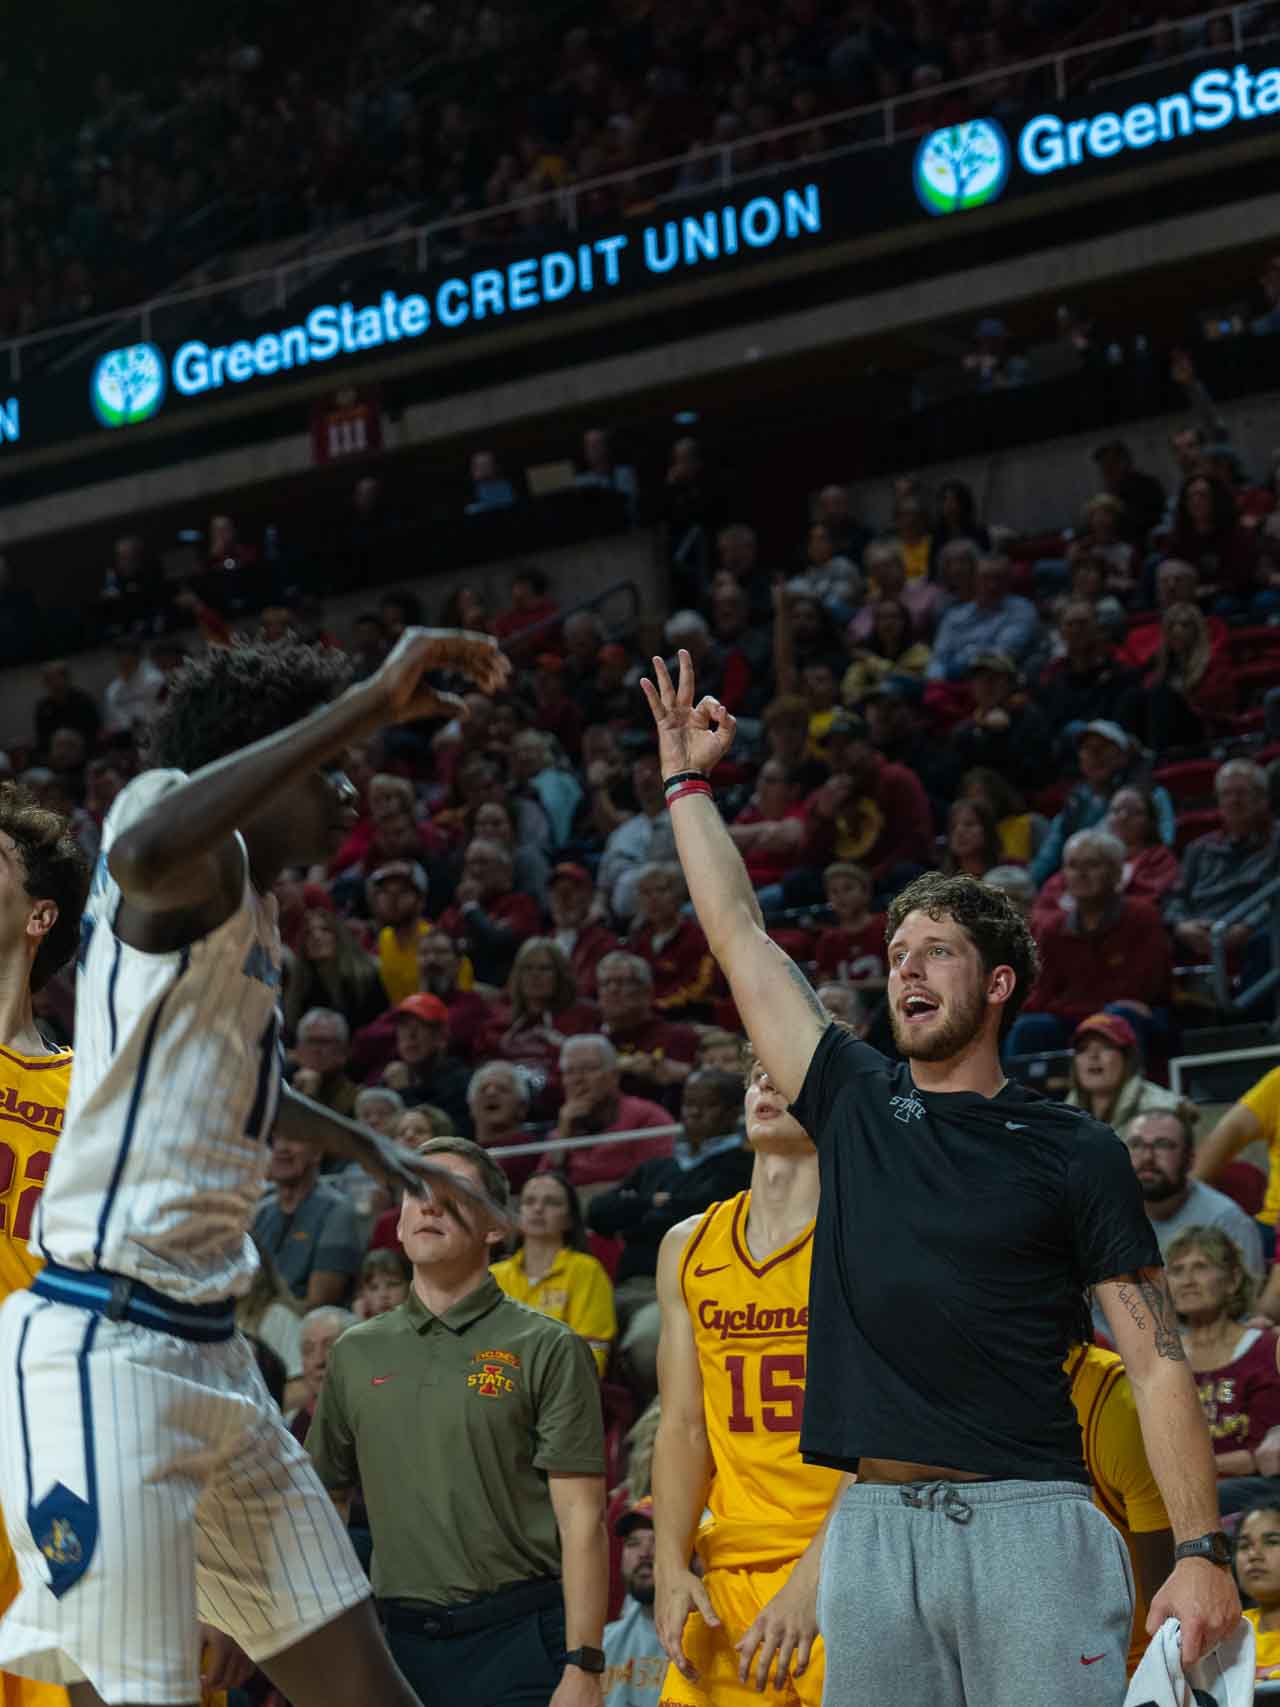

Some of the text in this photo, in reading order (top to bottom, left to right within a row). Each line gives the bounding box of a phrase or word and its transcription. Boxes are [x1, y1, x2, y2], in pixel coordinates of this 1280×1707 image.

[172, 184, 821, 396] GreenState CREDIT UNION
[466, 1372, 513, 1393] STATE
[725, 1355, 806, 1433] 15
